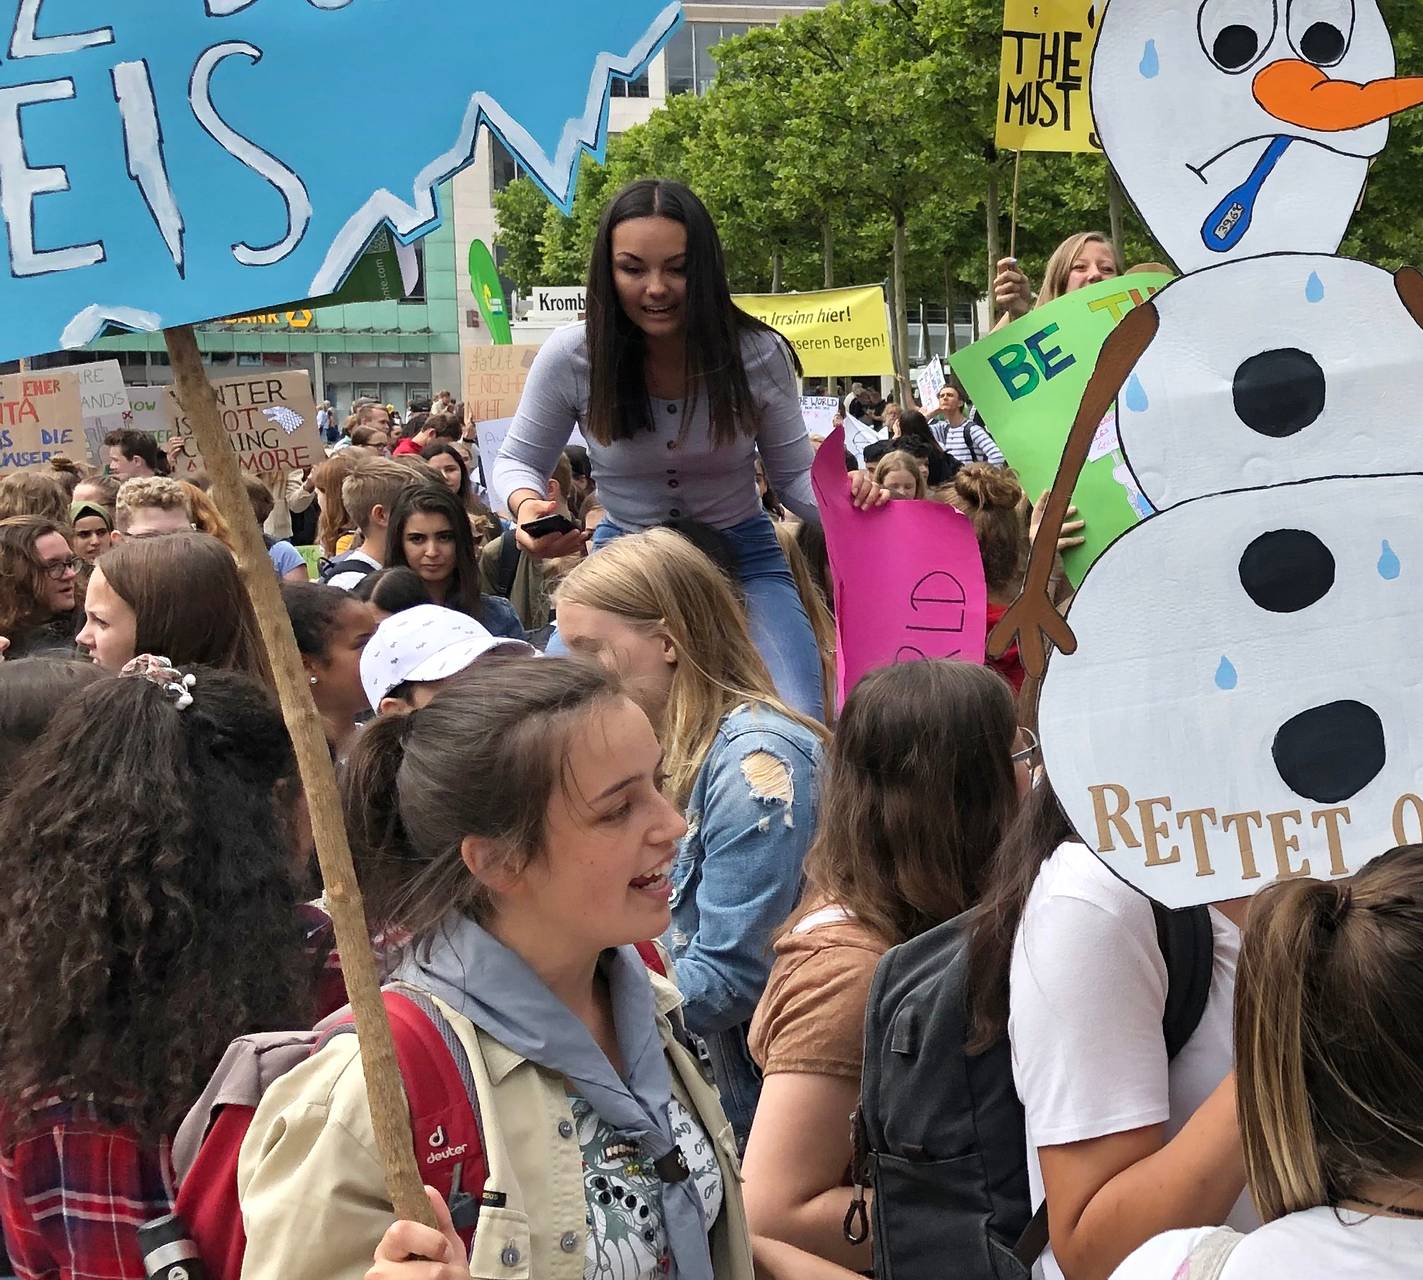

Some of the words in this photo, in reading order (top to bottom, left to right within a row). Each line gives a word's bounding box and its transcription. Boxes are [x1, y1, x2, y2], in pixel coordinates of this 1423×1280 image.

[1002, 30, 1083, 83] THE
[1004, 79, 1081, 131] MUST
[0, 40, 313, 280] EIS
[770, 310, 815, 326] Irrsinn
[816, 305, 852, 323] hier!
[833, 333, 885, 351] Bergen!
[80, 367, 105, 384] RE
[987, 322, 1077, 402] BE
[169, 379, 287, 412] NTER
[41, 428, 74, 445] DIE
[175, 416, 193, 437] IS
[219, 407, 260, 433] OT
[182, 427, 280, 459] CING
[239, 446, 312, 474] MORE
[1087, 783, 1352, 881] RETTET
[426, 1143, 468, 1165] deuter
